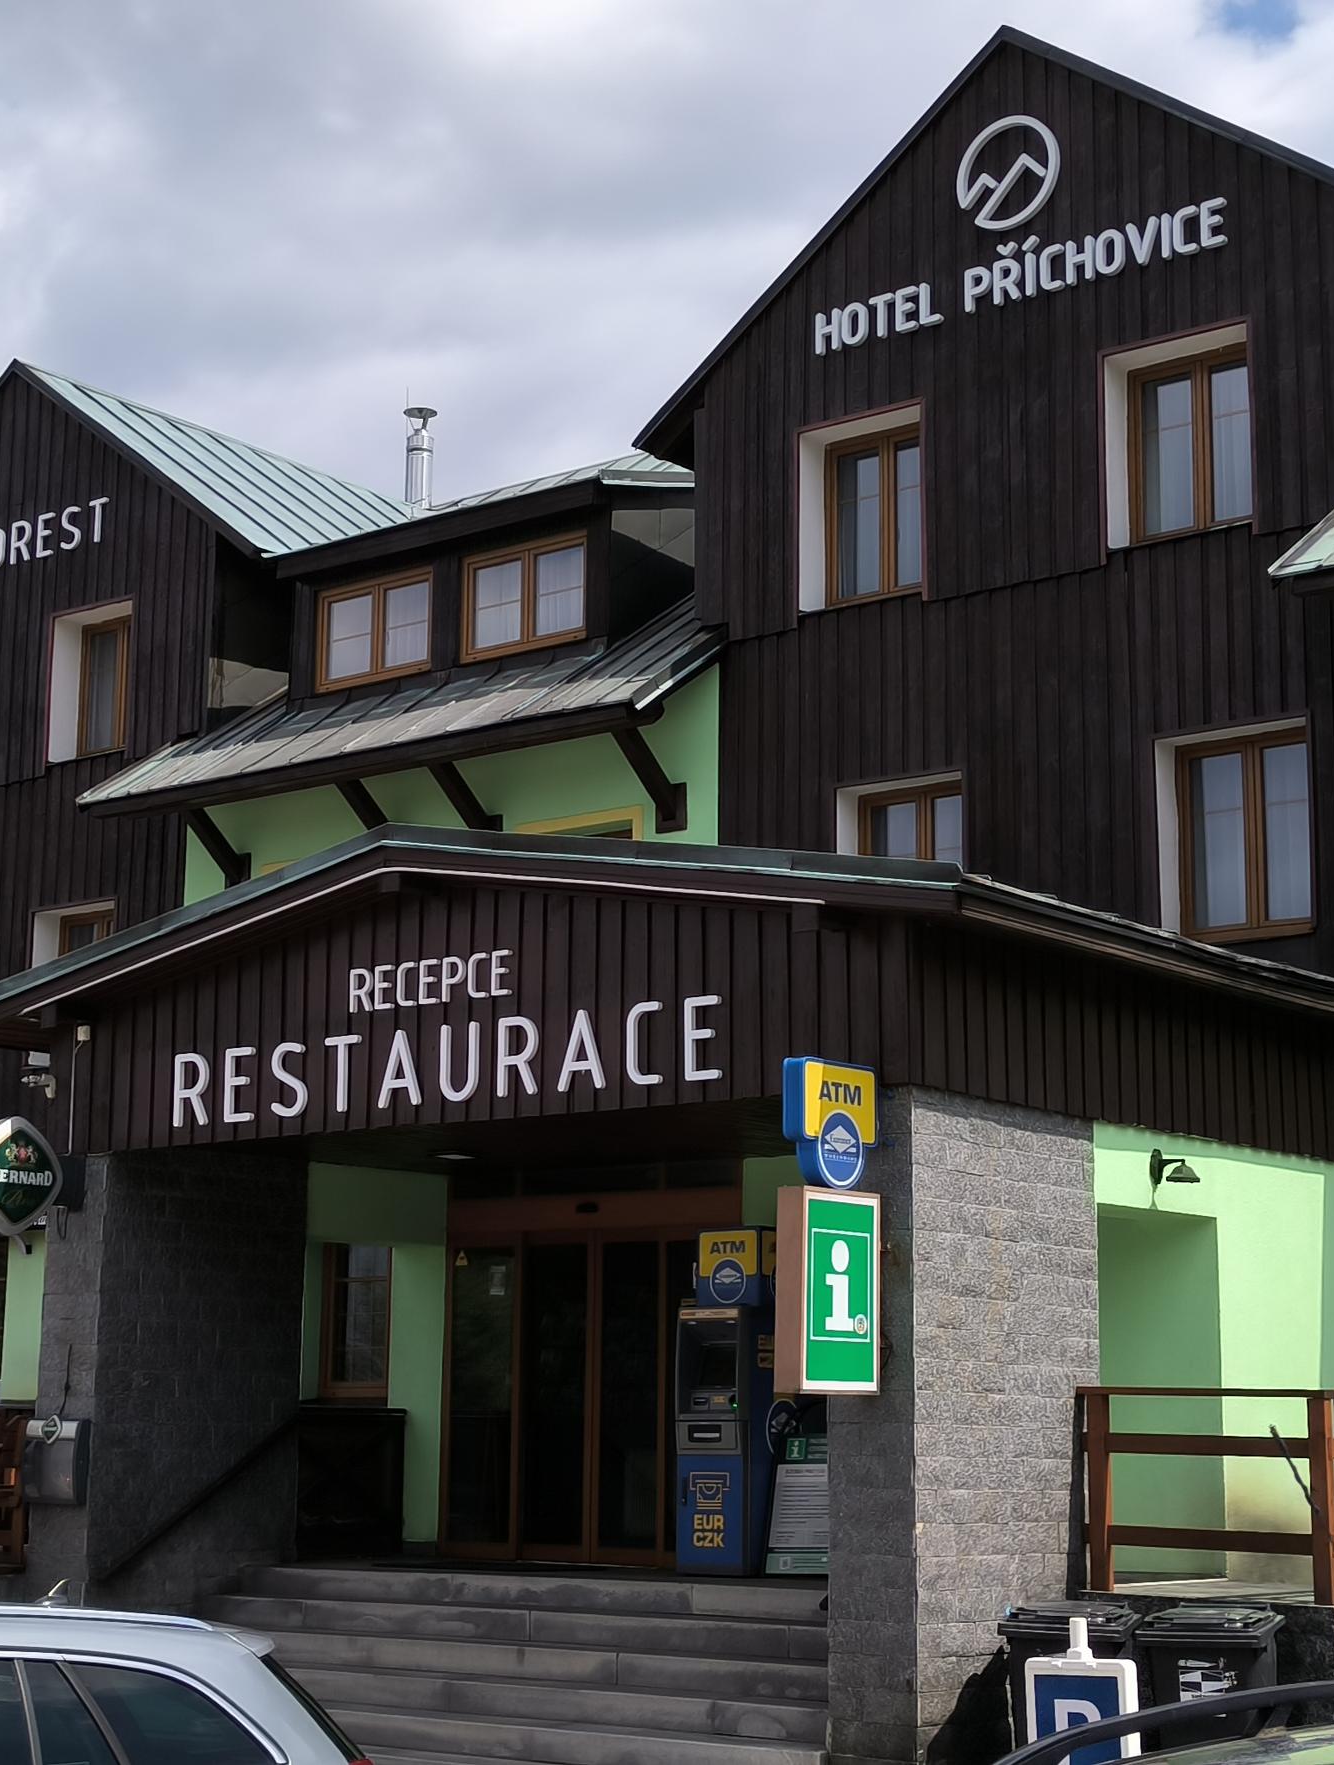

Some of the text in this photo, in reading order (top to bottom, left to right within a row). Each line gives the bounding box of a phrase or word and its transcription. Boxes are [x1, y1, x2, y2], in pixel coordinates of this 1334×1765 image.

[814, 195, 1229, 356] HOTEL PŘÍCHOVICE
[348, 948, 514, 1013] RECEPCE
[172, 994, 724, 1128] RESTAURACE
[819, 1080, 862, 1106] ATM
[710, 1240, 746, 1255] ATM
[693, 1513, 725, 1530] EUR
[693, 1531, 726, 1548] CZK
